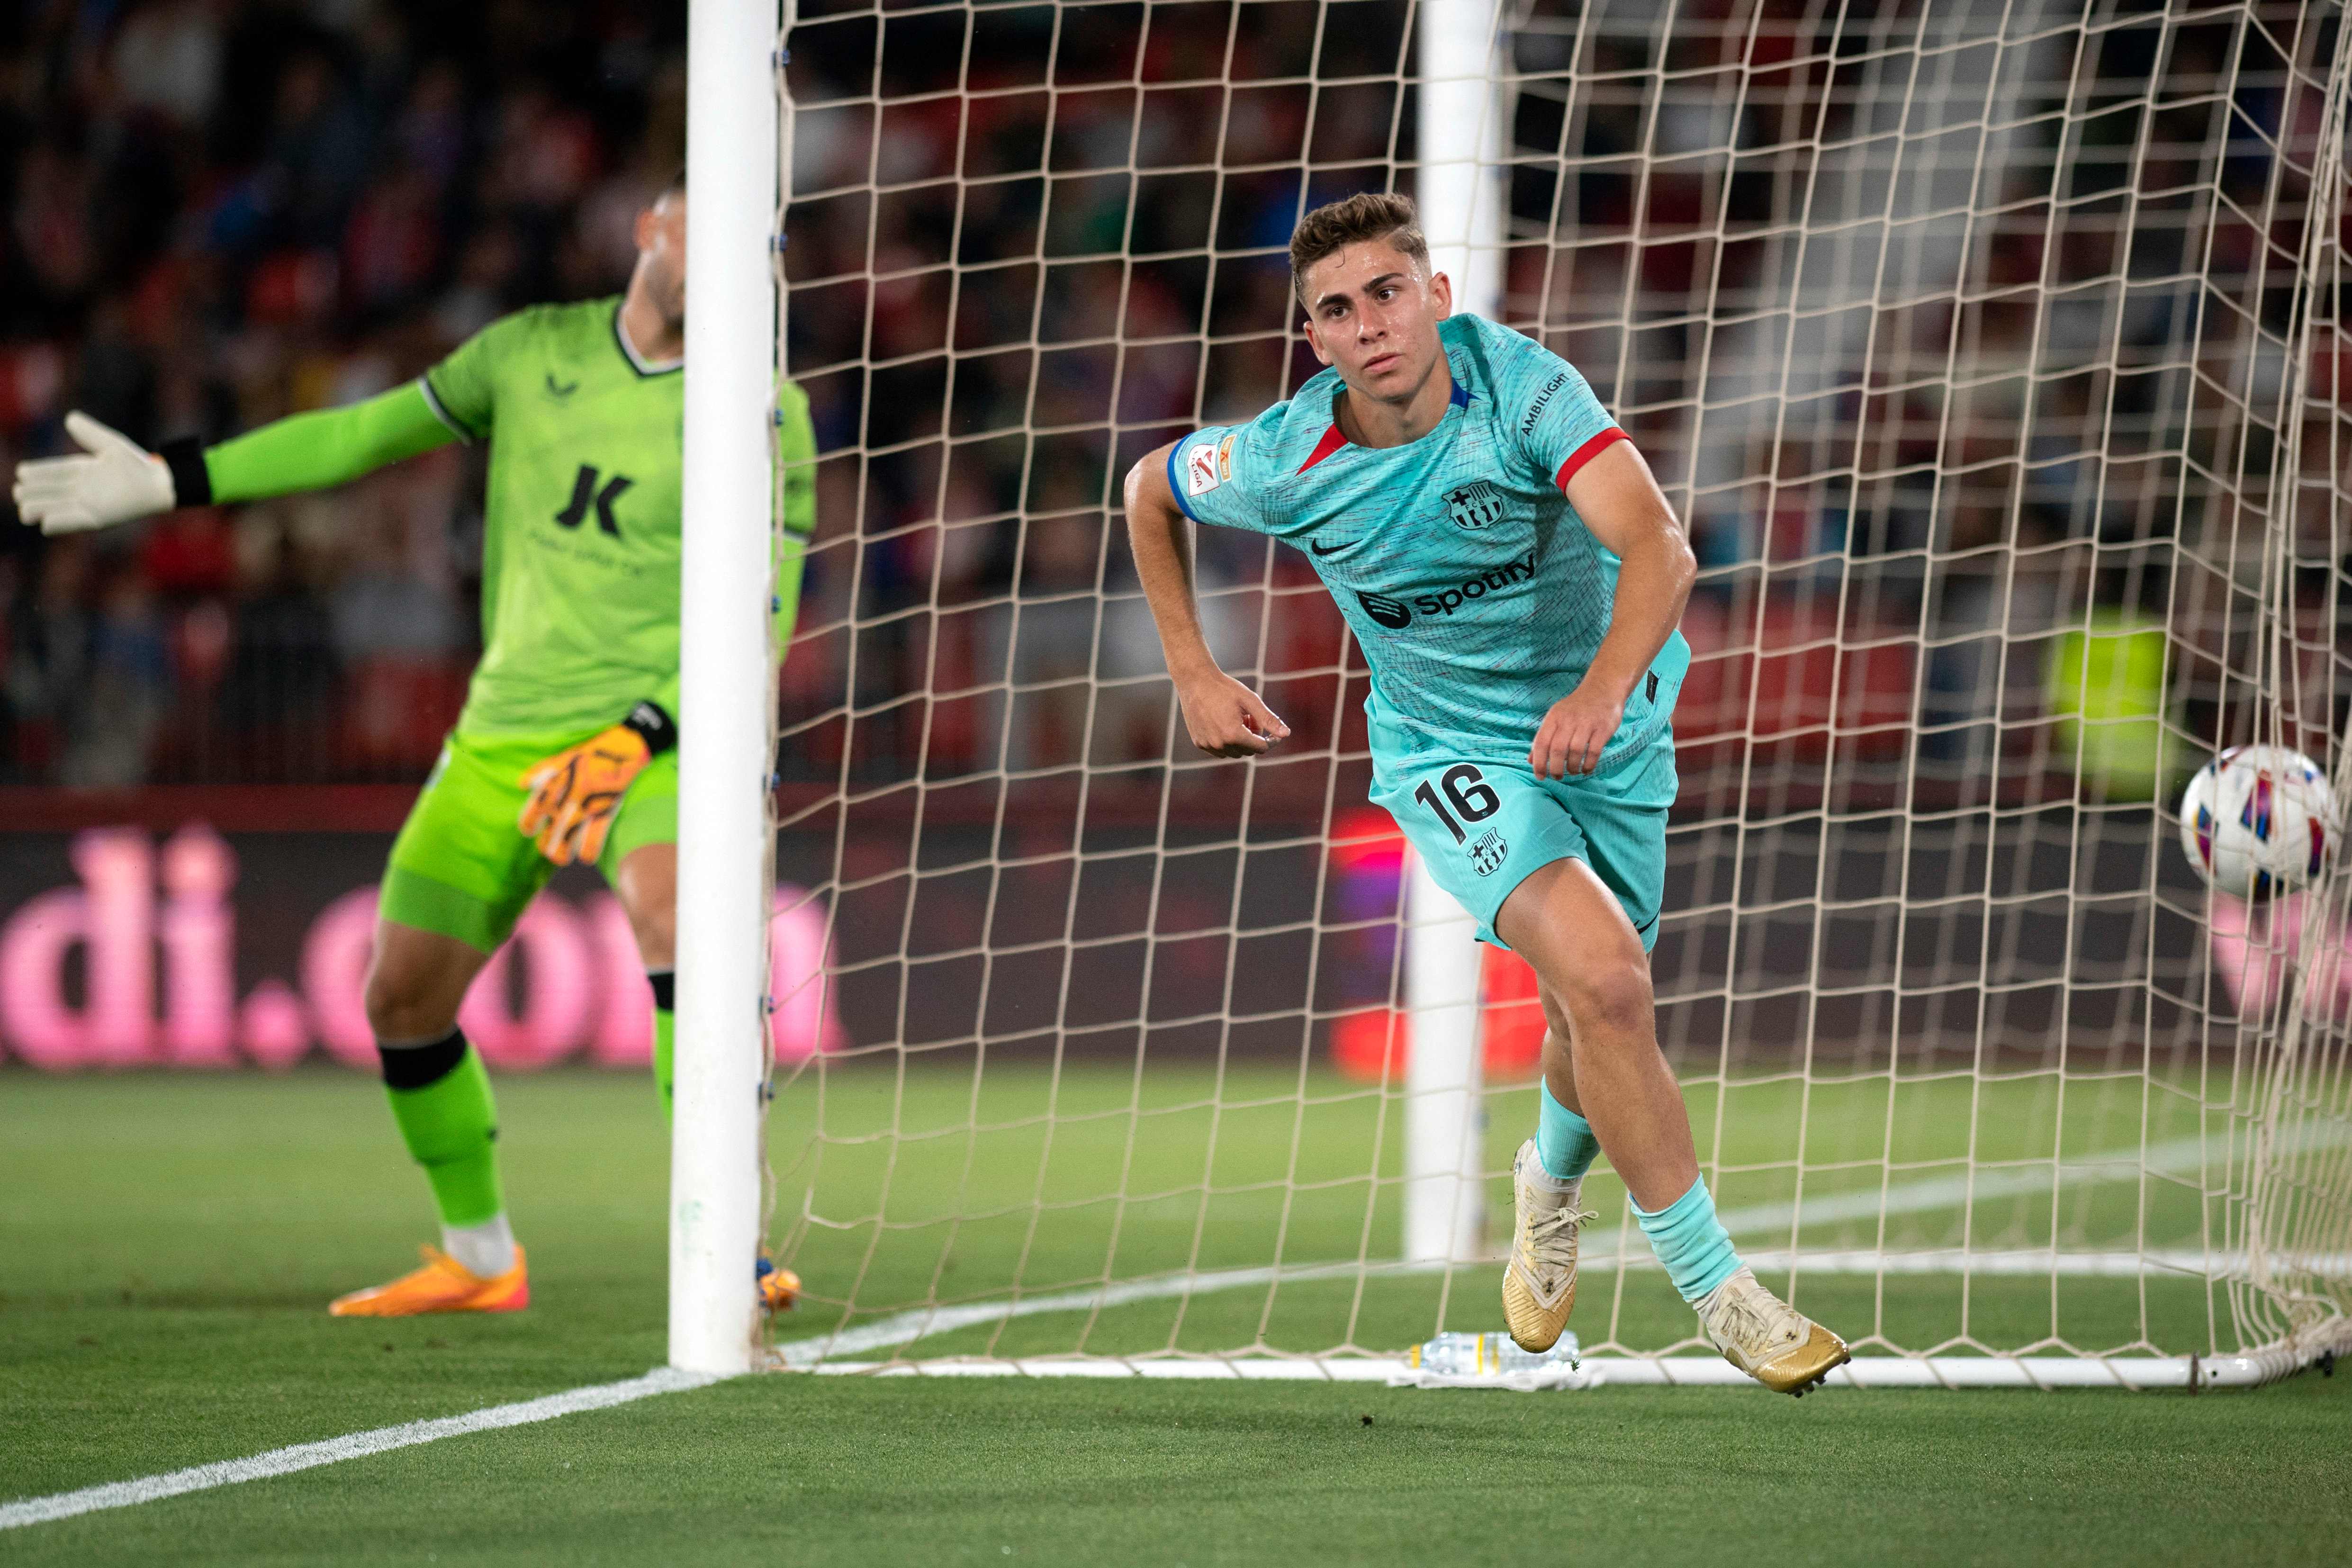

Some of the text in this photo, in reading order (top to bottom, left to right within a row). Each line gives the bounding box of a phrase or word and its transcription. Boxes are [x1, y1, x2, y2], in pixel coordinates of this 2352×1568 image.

[1521, 372, 1569, 437] AMBILIGHT
[553, 464, 634, 539] JK
[1414, 552, 1536, 616] Spotify
[1414, 763, 1501, 847] 16
